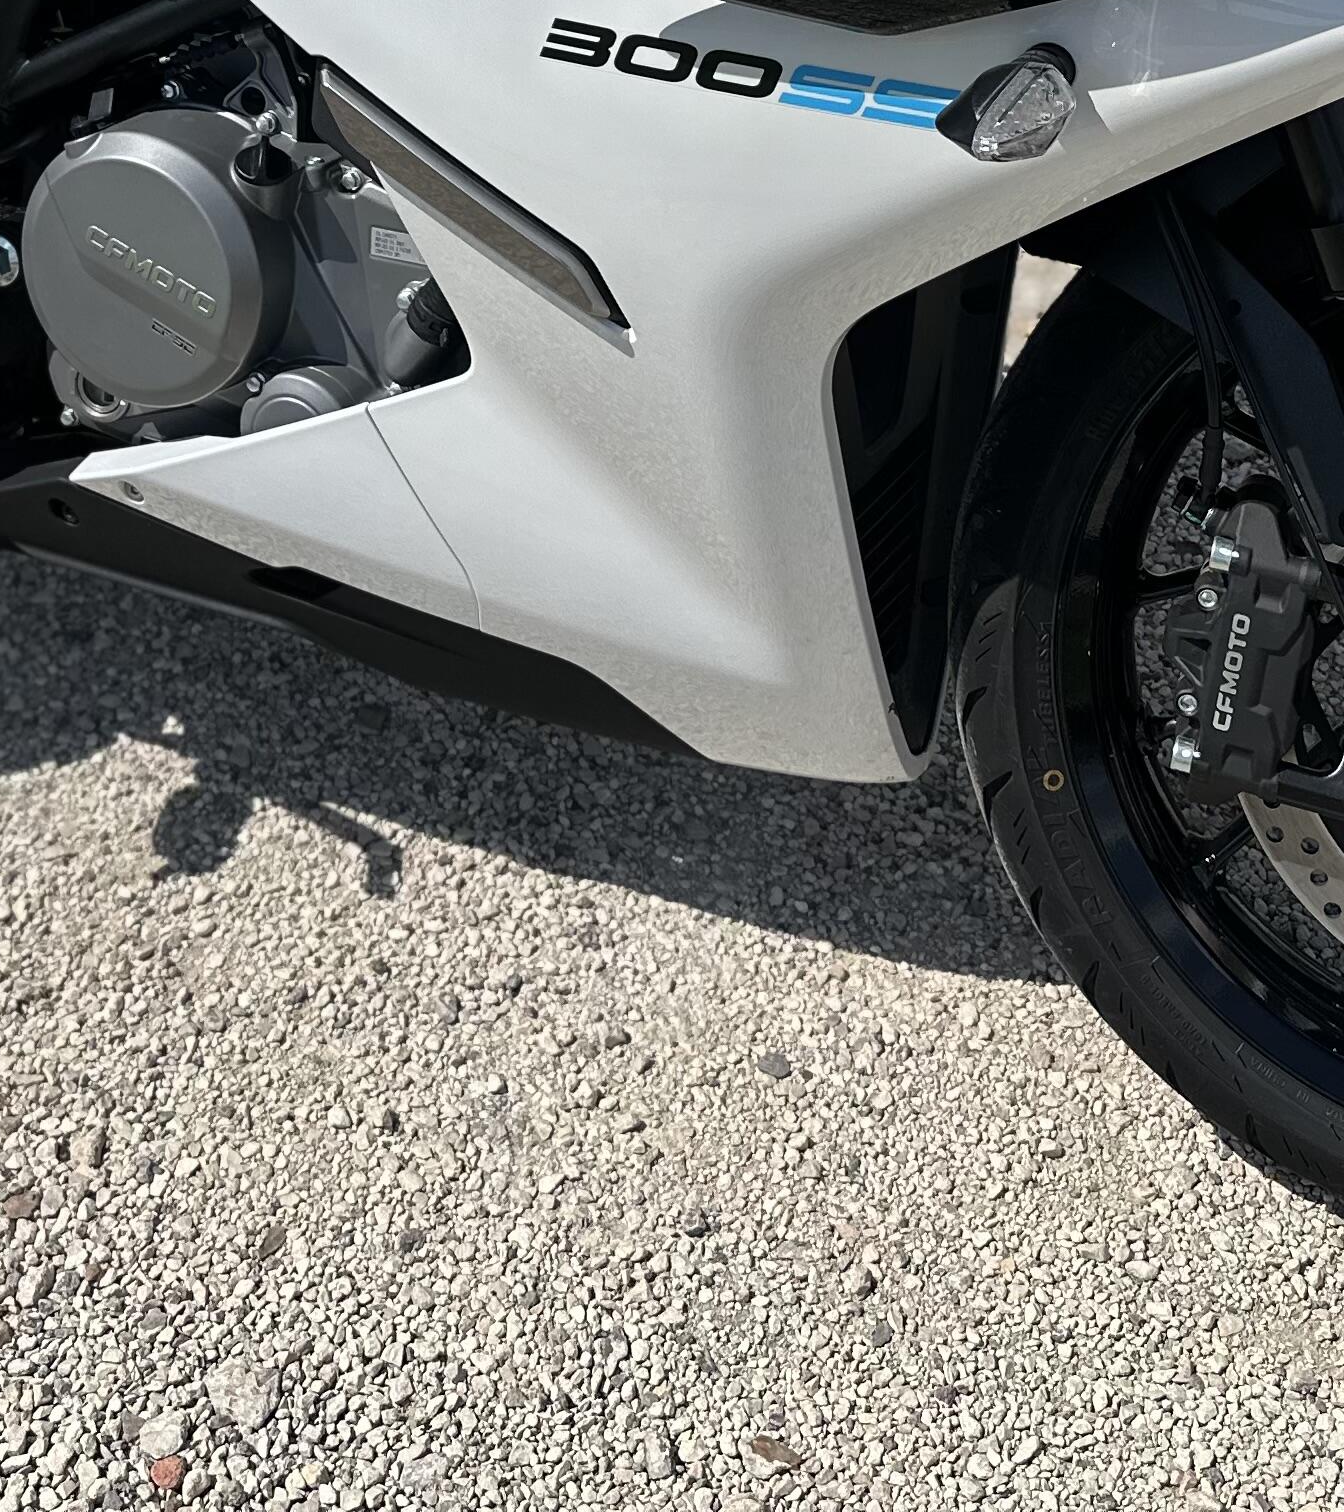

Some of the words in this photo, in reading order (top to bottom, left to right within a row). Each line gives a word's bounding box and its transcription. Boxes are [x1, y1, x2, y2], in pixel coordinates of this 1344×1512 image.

[540, 18, 960, 130] 300SS
[85, 225, 217, 318] CFMOTO
[1212, 613, 1251, 732] CFMOTO
